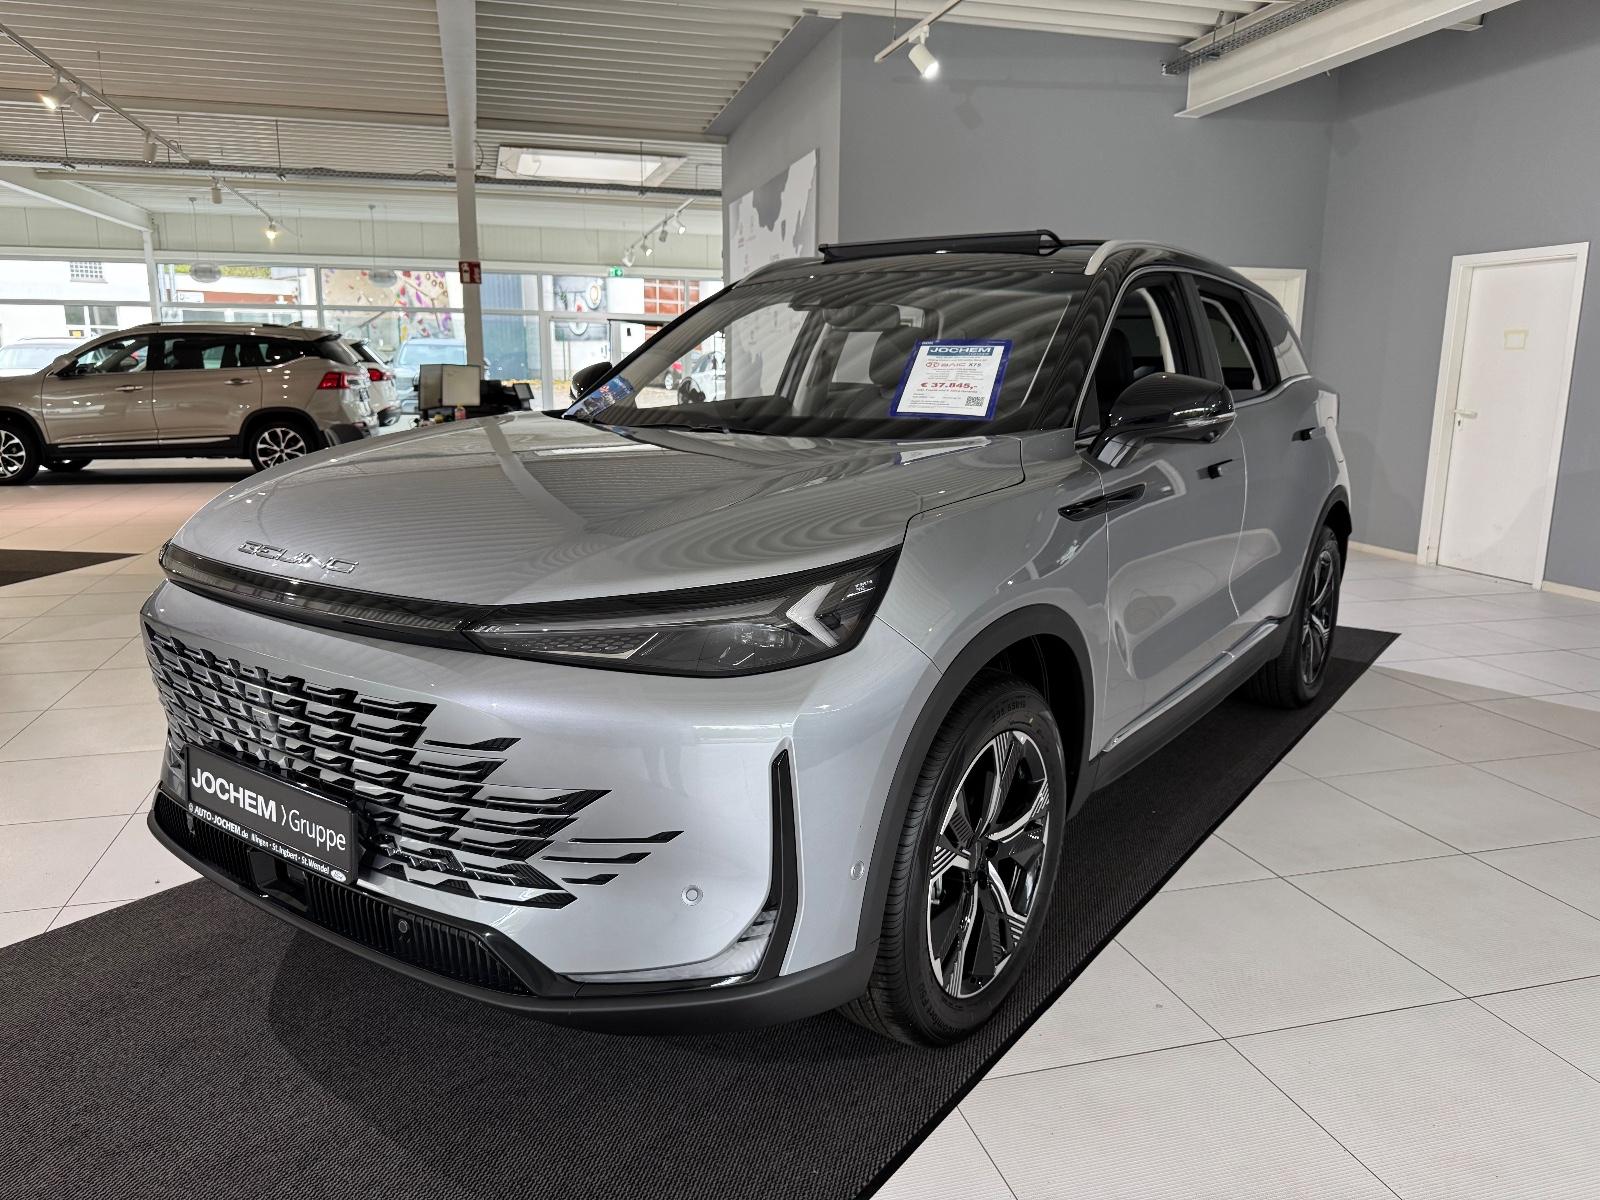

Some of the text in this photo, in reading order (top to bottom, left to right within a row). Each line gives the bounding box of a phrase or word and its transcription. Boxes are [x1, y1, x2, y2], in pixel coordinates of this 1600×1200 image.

[191, 768, 347, 852] JOCHEM Gruppe
[194, 805, 249, 839] AUTO-JOCHEM.de
